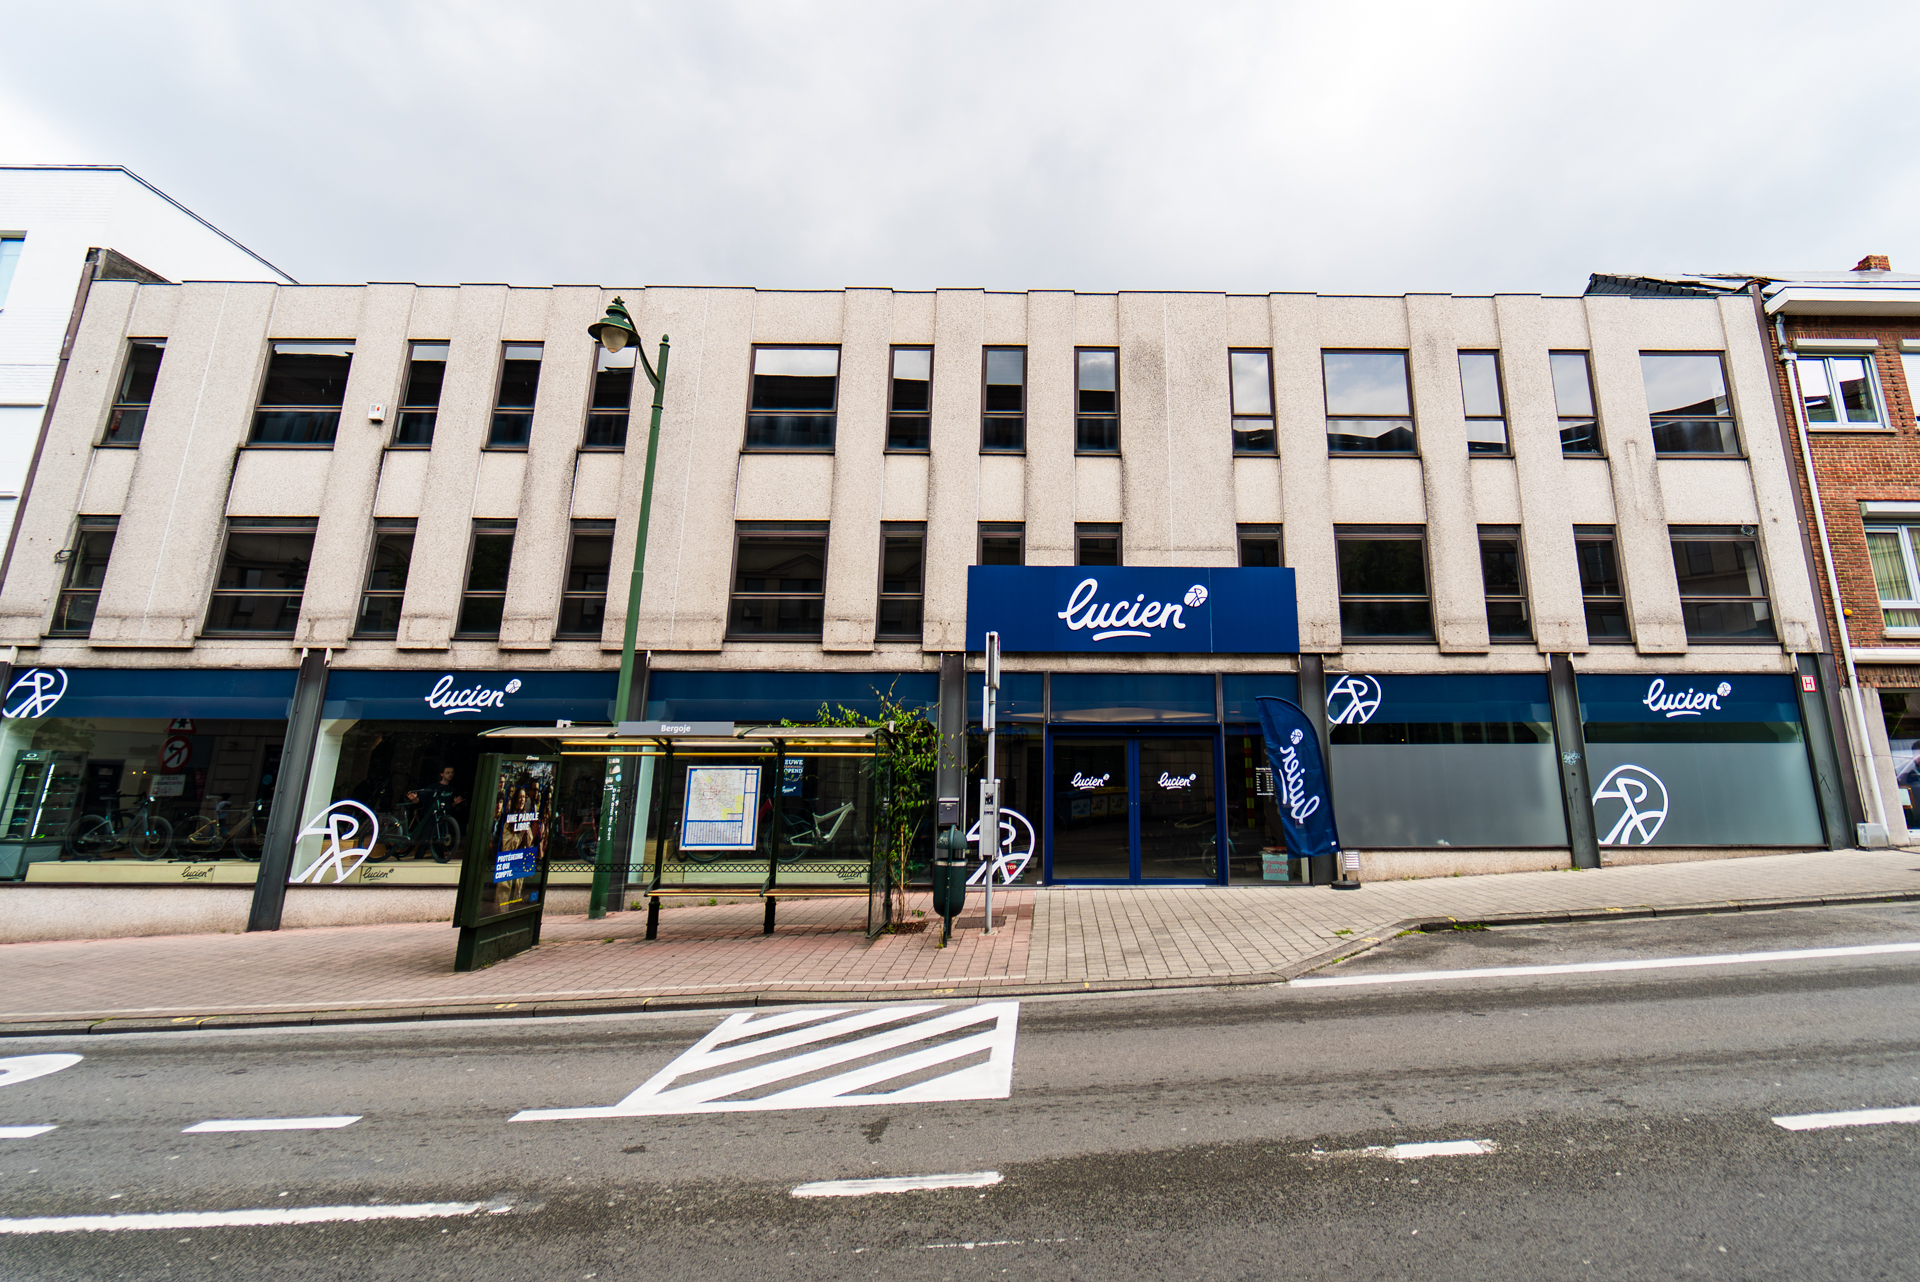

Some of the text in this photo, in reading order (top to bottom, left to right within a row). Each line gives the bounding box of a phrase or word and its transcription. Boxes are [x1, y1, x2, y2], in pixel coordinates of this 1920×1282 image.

[1057, 578, 1186, 631] lucien
[1804, 678, 1813, 689] H
[424, 675, 504, 708] lucien
[1642, 678, 1721, 711] lucien
[660, 724, 691, 734] Bergoje
[1071, 772, 1104, 787] lucien
[1158, 772, 1190, 787] lucien
[506, 812, 539, 823] UNE PAROLE
[514, 822, 531, 832] LIBRE
